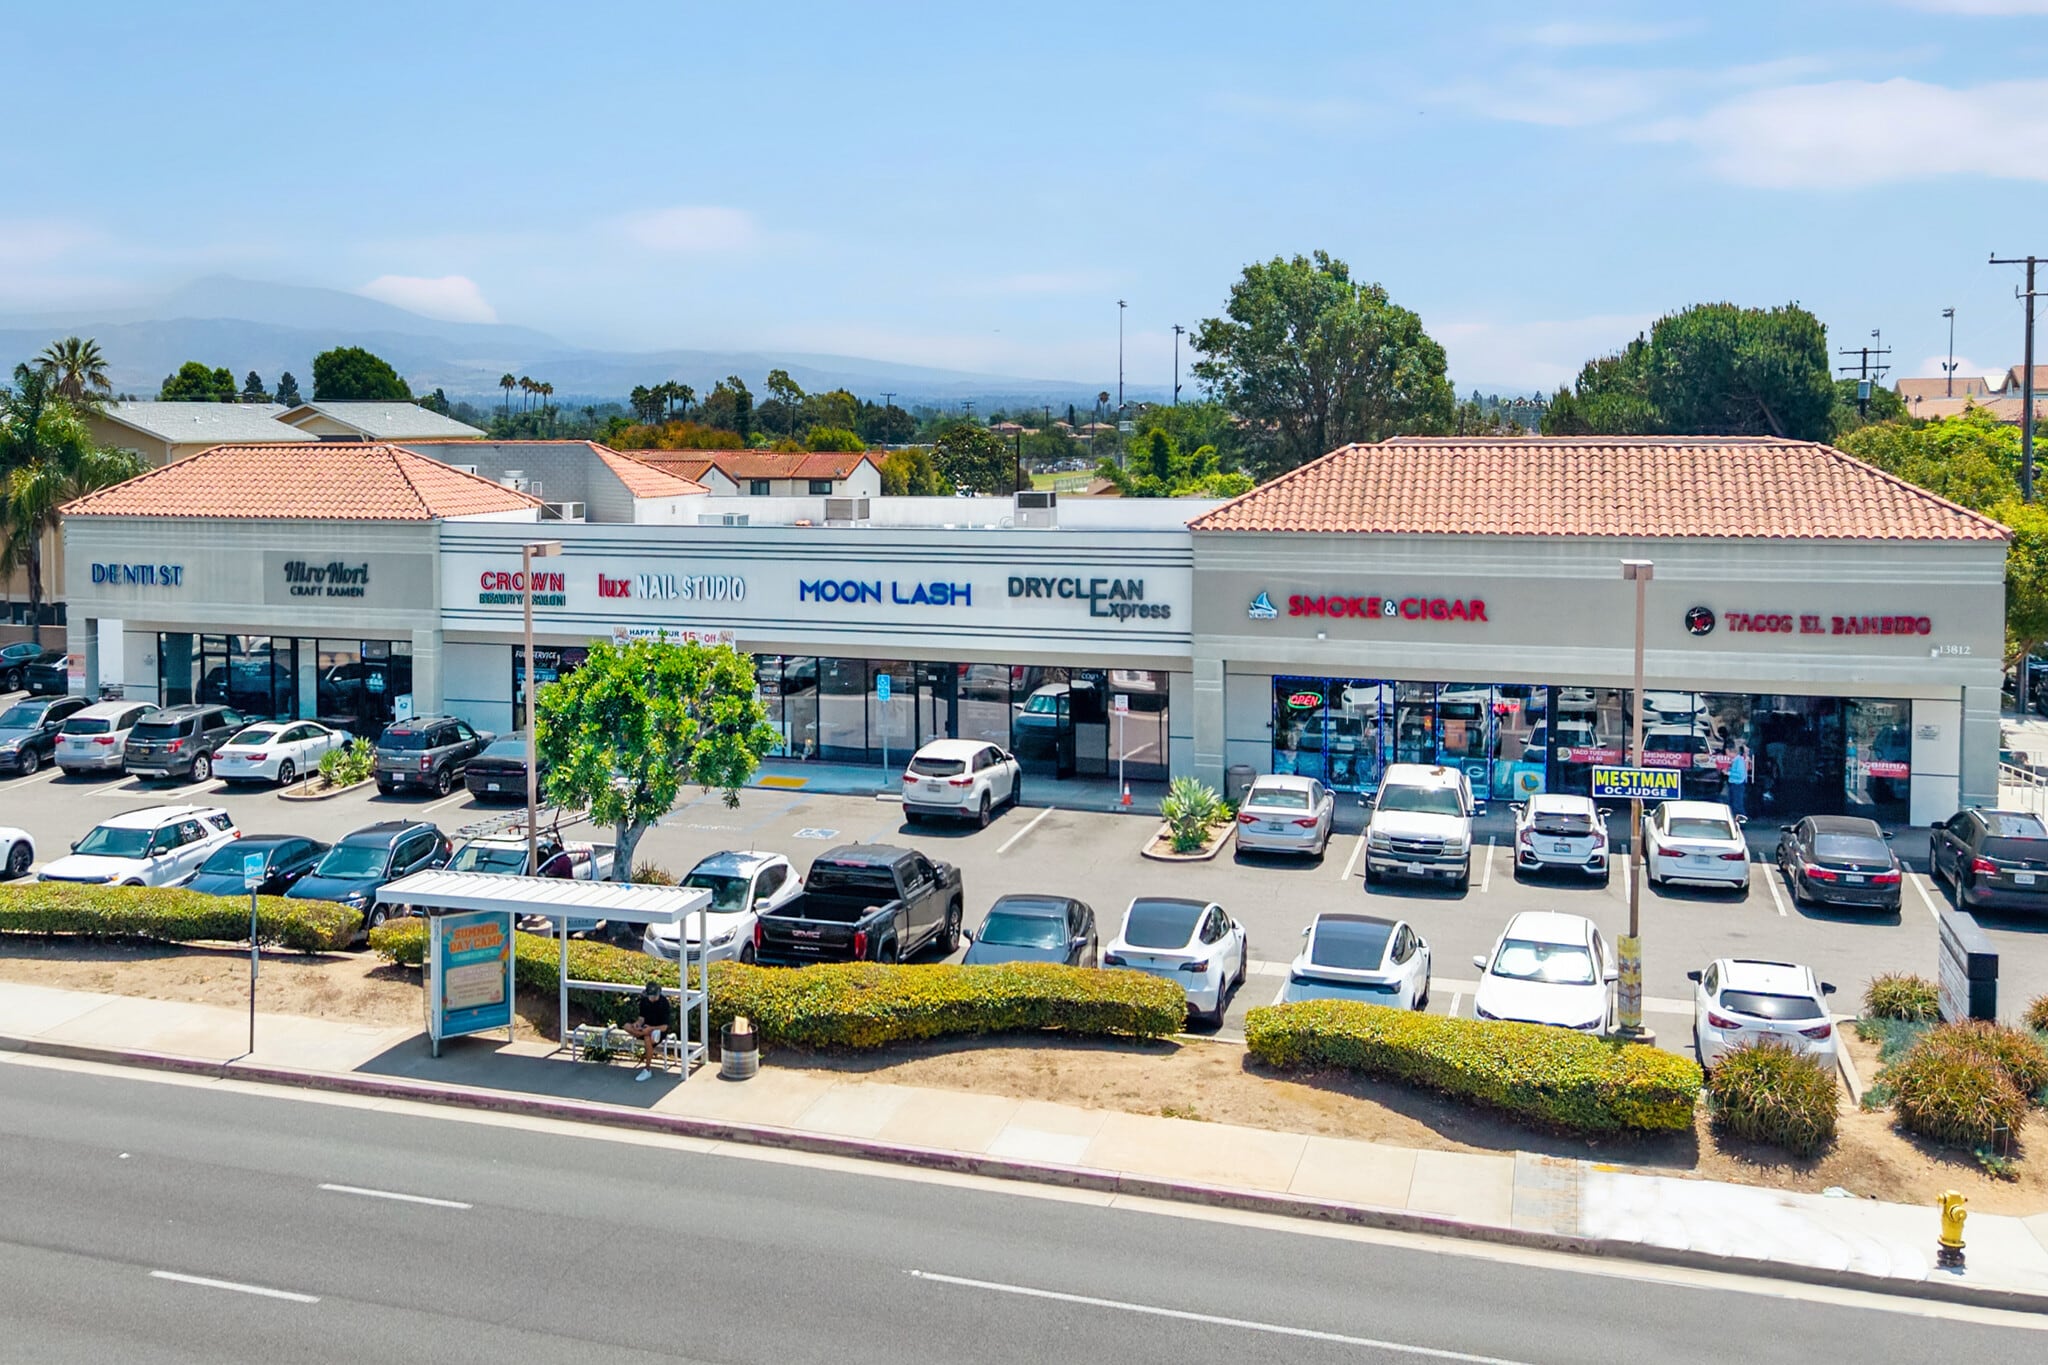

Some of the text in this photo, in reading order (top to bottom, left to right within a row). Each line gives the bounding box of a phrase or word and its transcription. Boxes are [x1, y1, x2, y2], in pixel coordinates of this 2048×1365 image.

[92, 563, 183, 586] DENTIST
[290, 586, 364, 597] CRAFT RAMEN
[598, 573, 745, 602] lux NAIL STUDIO
[799, 579, 972, 606] MOON LASH
[1008, 577, 1143, 609] DRYCLEAN
[1288, 595, 1382, 618] SMOKE
[1384, 600, 1397, 616] &
[1400, 598, 1488, 621] CIGAR
[1724, 613, 1793, 632] TACOS
[1799, 615, 1825, 634] EL
[1939, 645, 1971, 655] 13812
[1290, 694, 1318, 706] OPEN
[1643, 752, 1681, 760] MENUDO
[1595, 771, 1678, 788] MESTMAN
[1604, 787, 1667, 796] OC JUDGE
[453, 923, 499, 939] SUMMER
[792, 930, 820, 938] GMC
[449, 934, 503, 953] DAY CAMP
